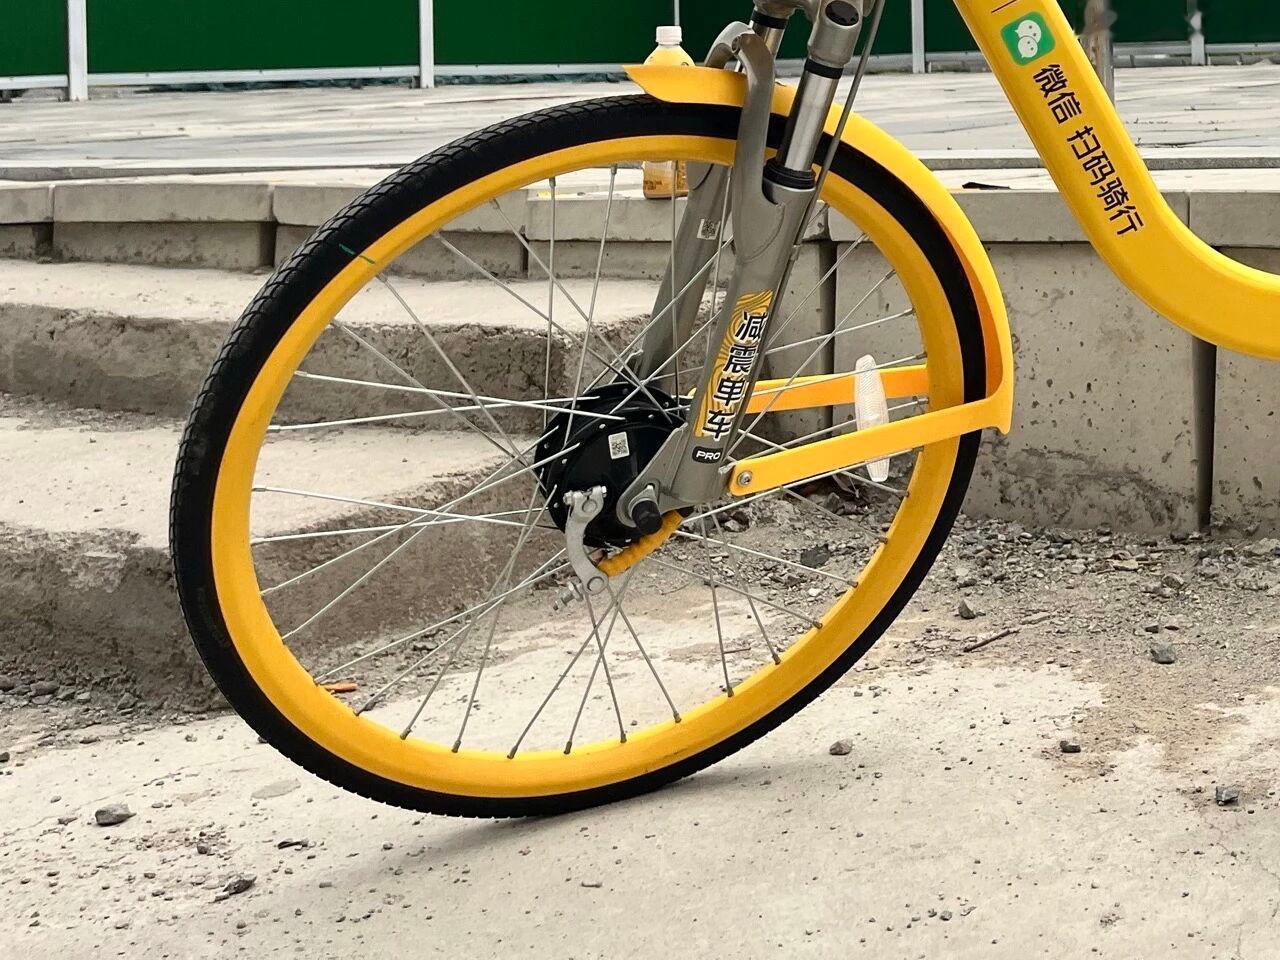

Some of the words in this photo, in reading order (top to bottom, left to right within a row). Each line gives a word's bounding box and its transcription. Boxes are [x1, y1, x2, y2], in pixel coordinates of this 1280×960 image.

[1033, 63, 1082, 124] 微信
[1066, 124, 1144, 237] 扫码骑行
[702, 310, 768, 442] 减震单车
[695, 450, 721, 461] PRO
